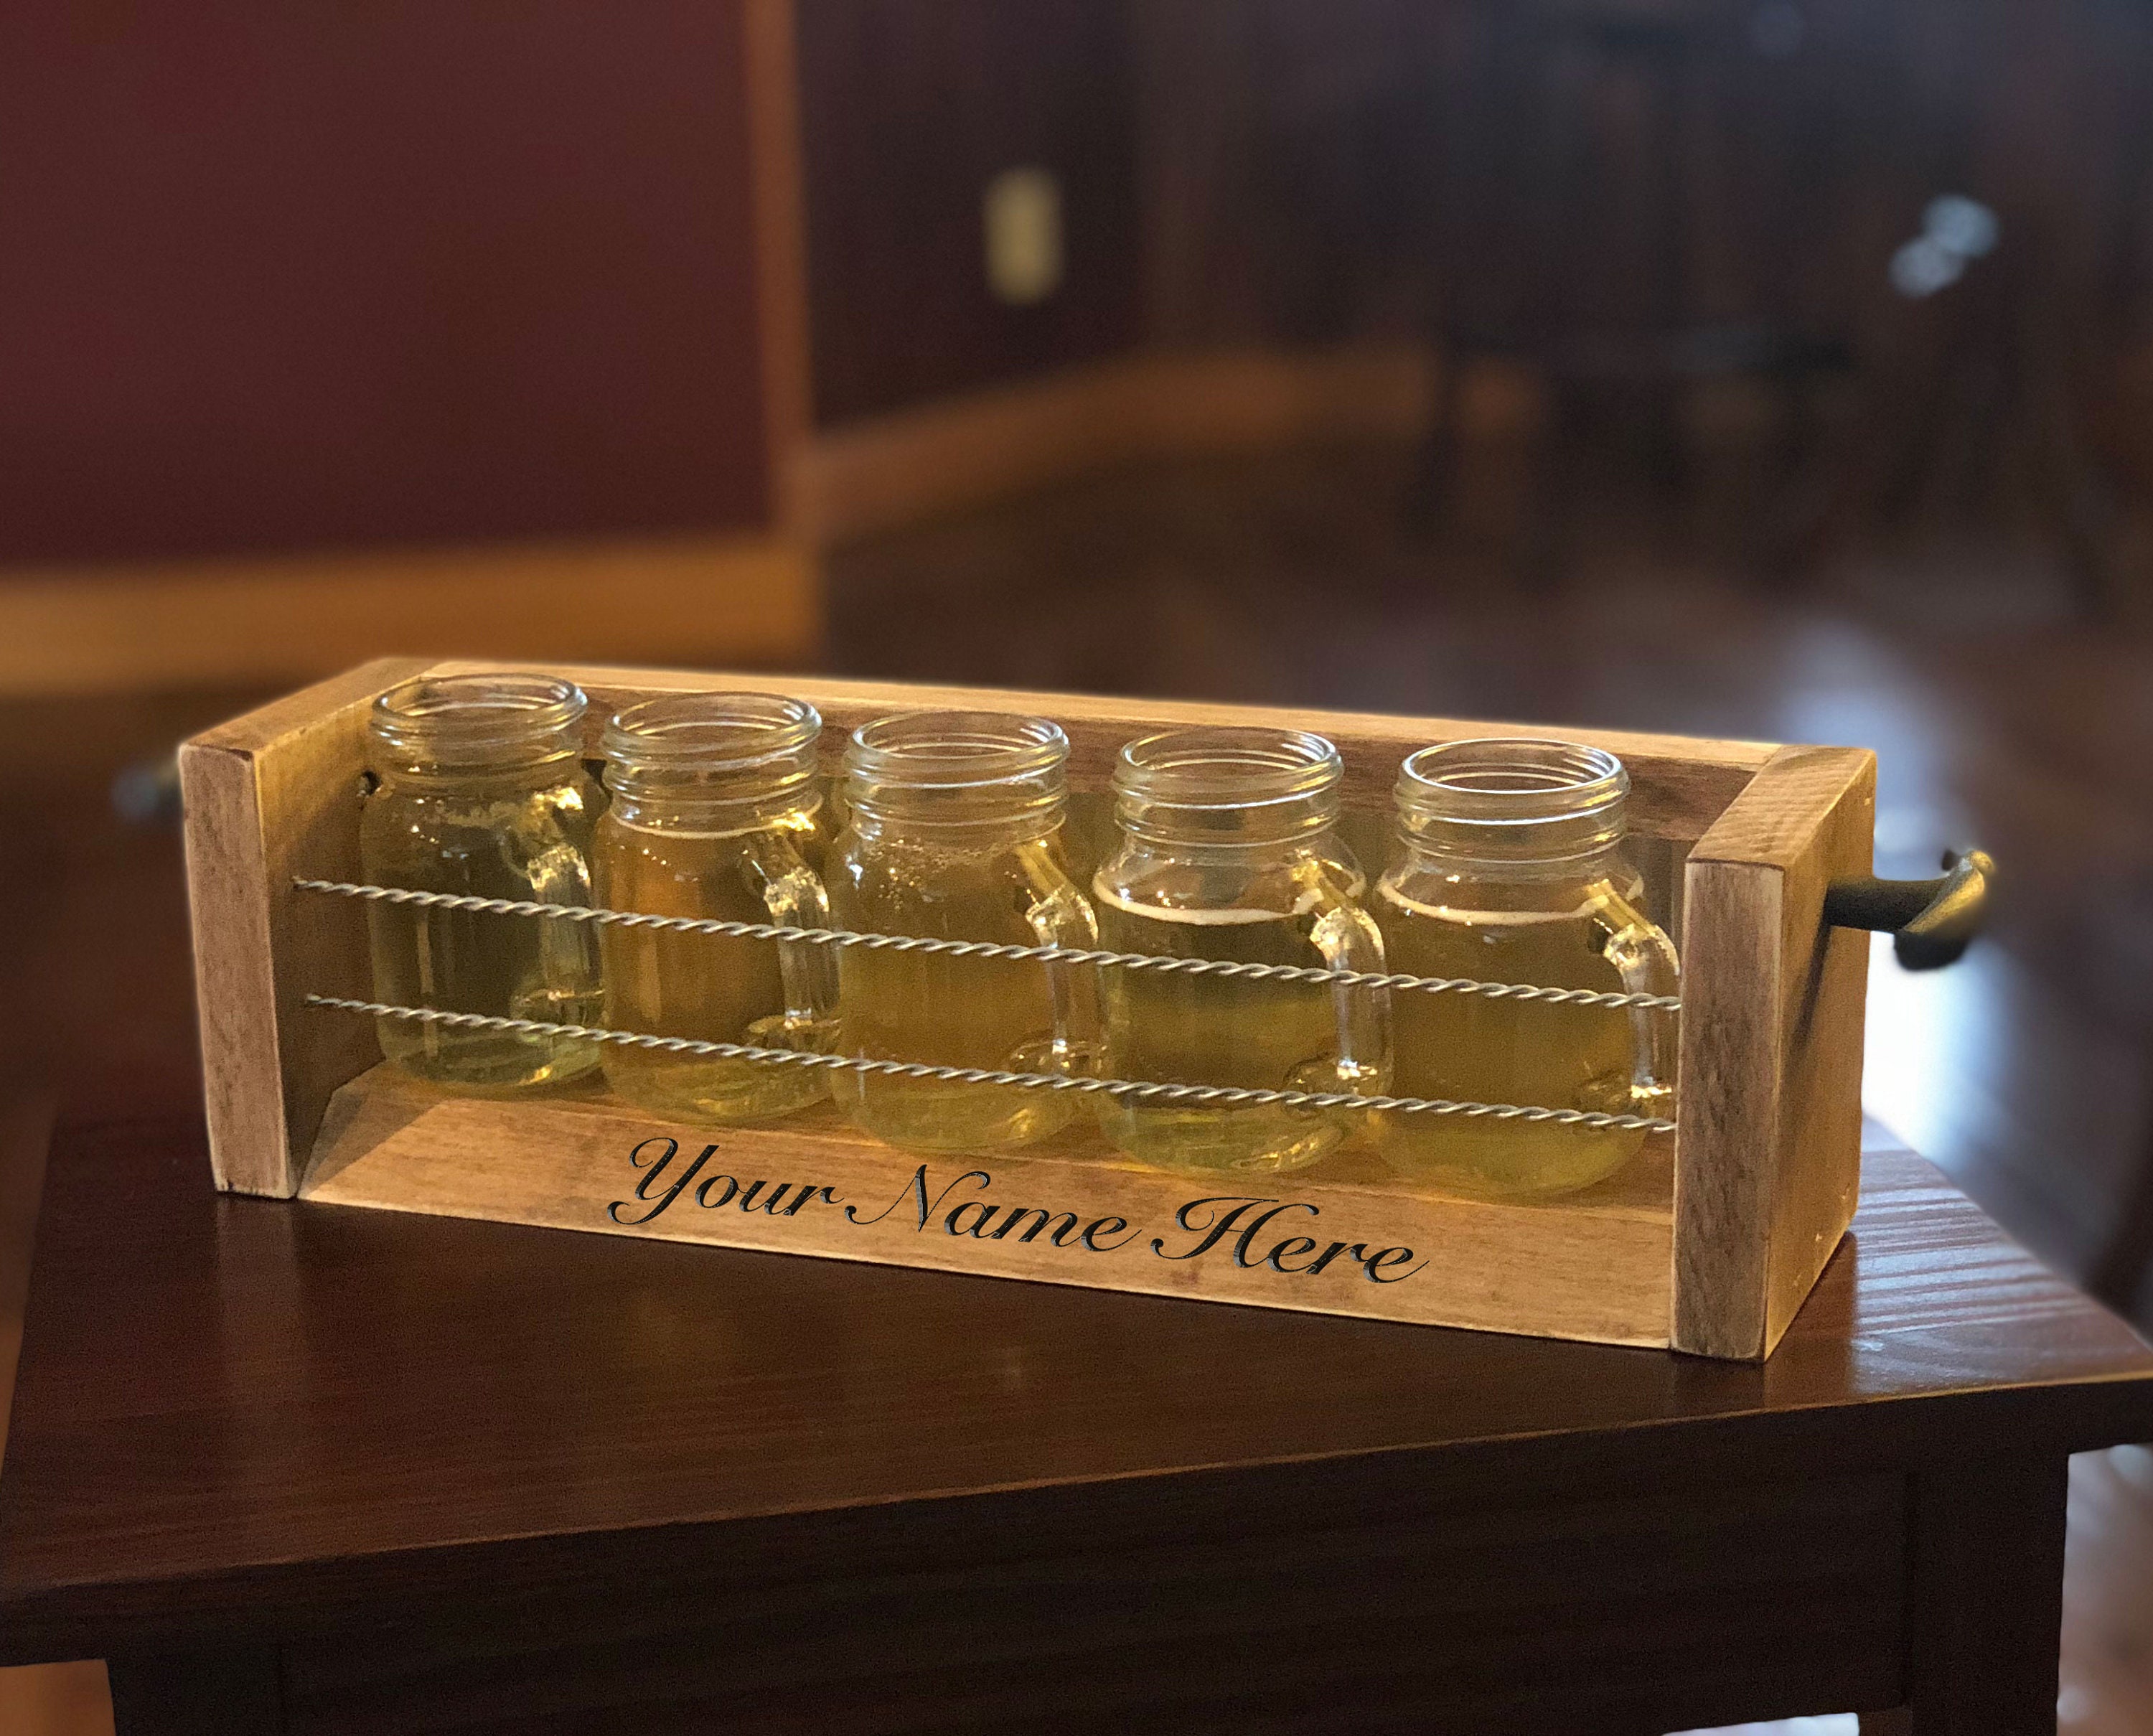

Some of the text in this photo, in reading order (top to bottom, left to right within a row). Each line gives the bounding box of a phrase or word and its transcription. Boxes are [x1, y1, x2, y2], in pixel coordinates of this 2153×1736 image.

[606, 1136, 1430, 1283] Your Name Here
